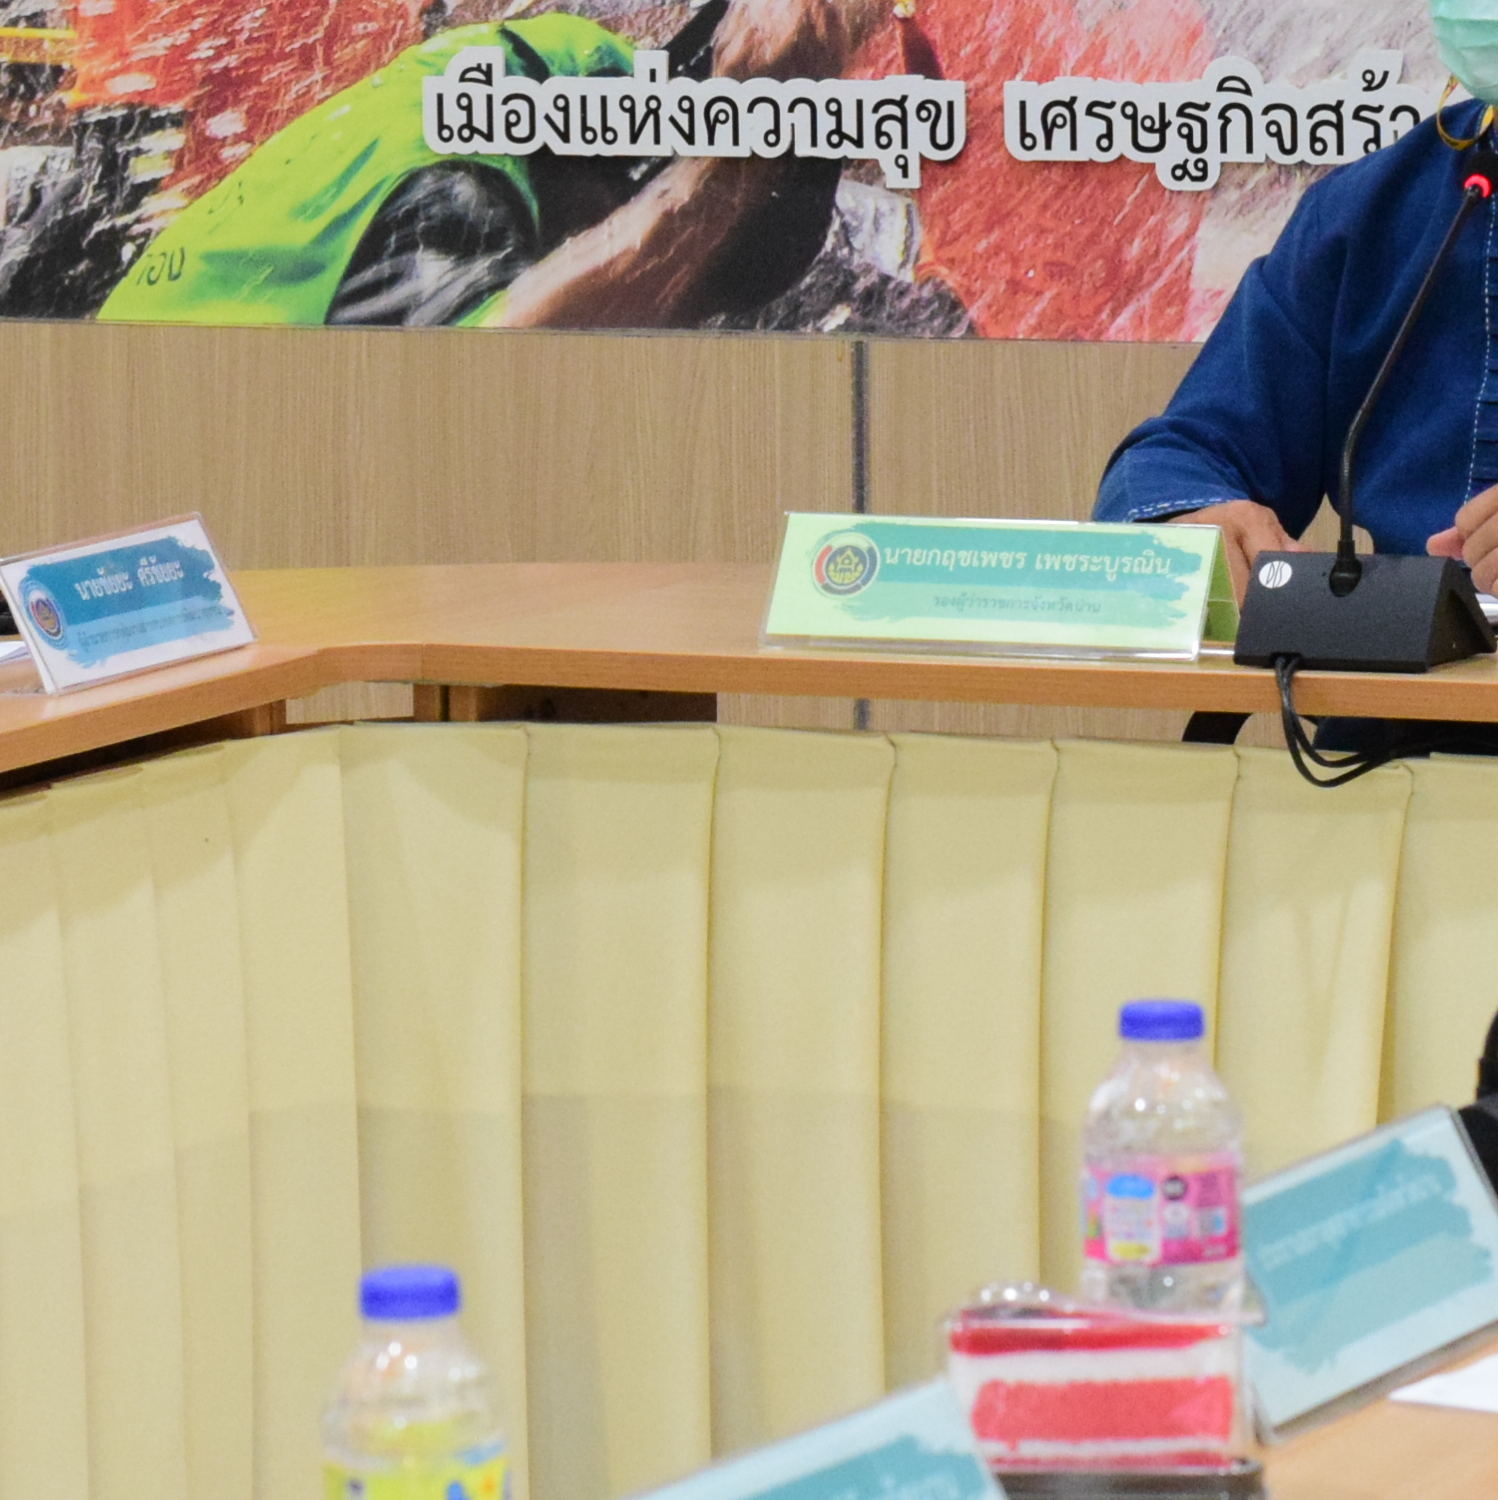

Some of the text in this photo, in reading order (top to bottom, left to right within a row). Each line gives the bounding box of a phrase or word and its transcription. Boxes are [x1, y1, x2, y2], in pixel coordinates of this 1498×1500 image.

[436, 63, 955, 179] เมืองแห่งความสุข
